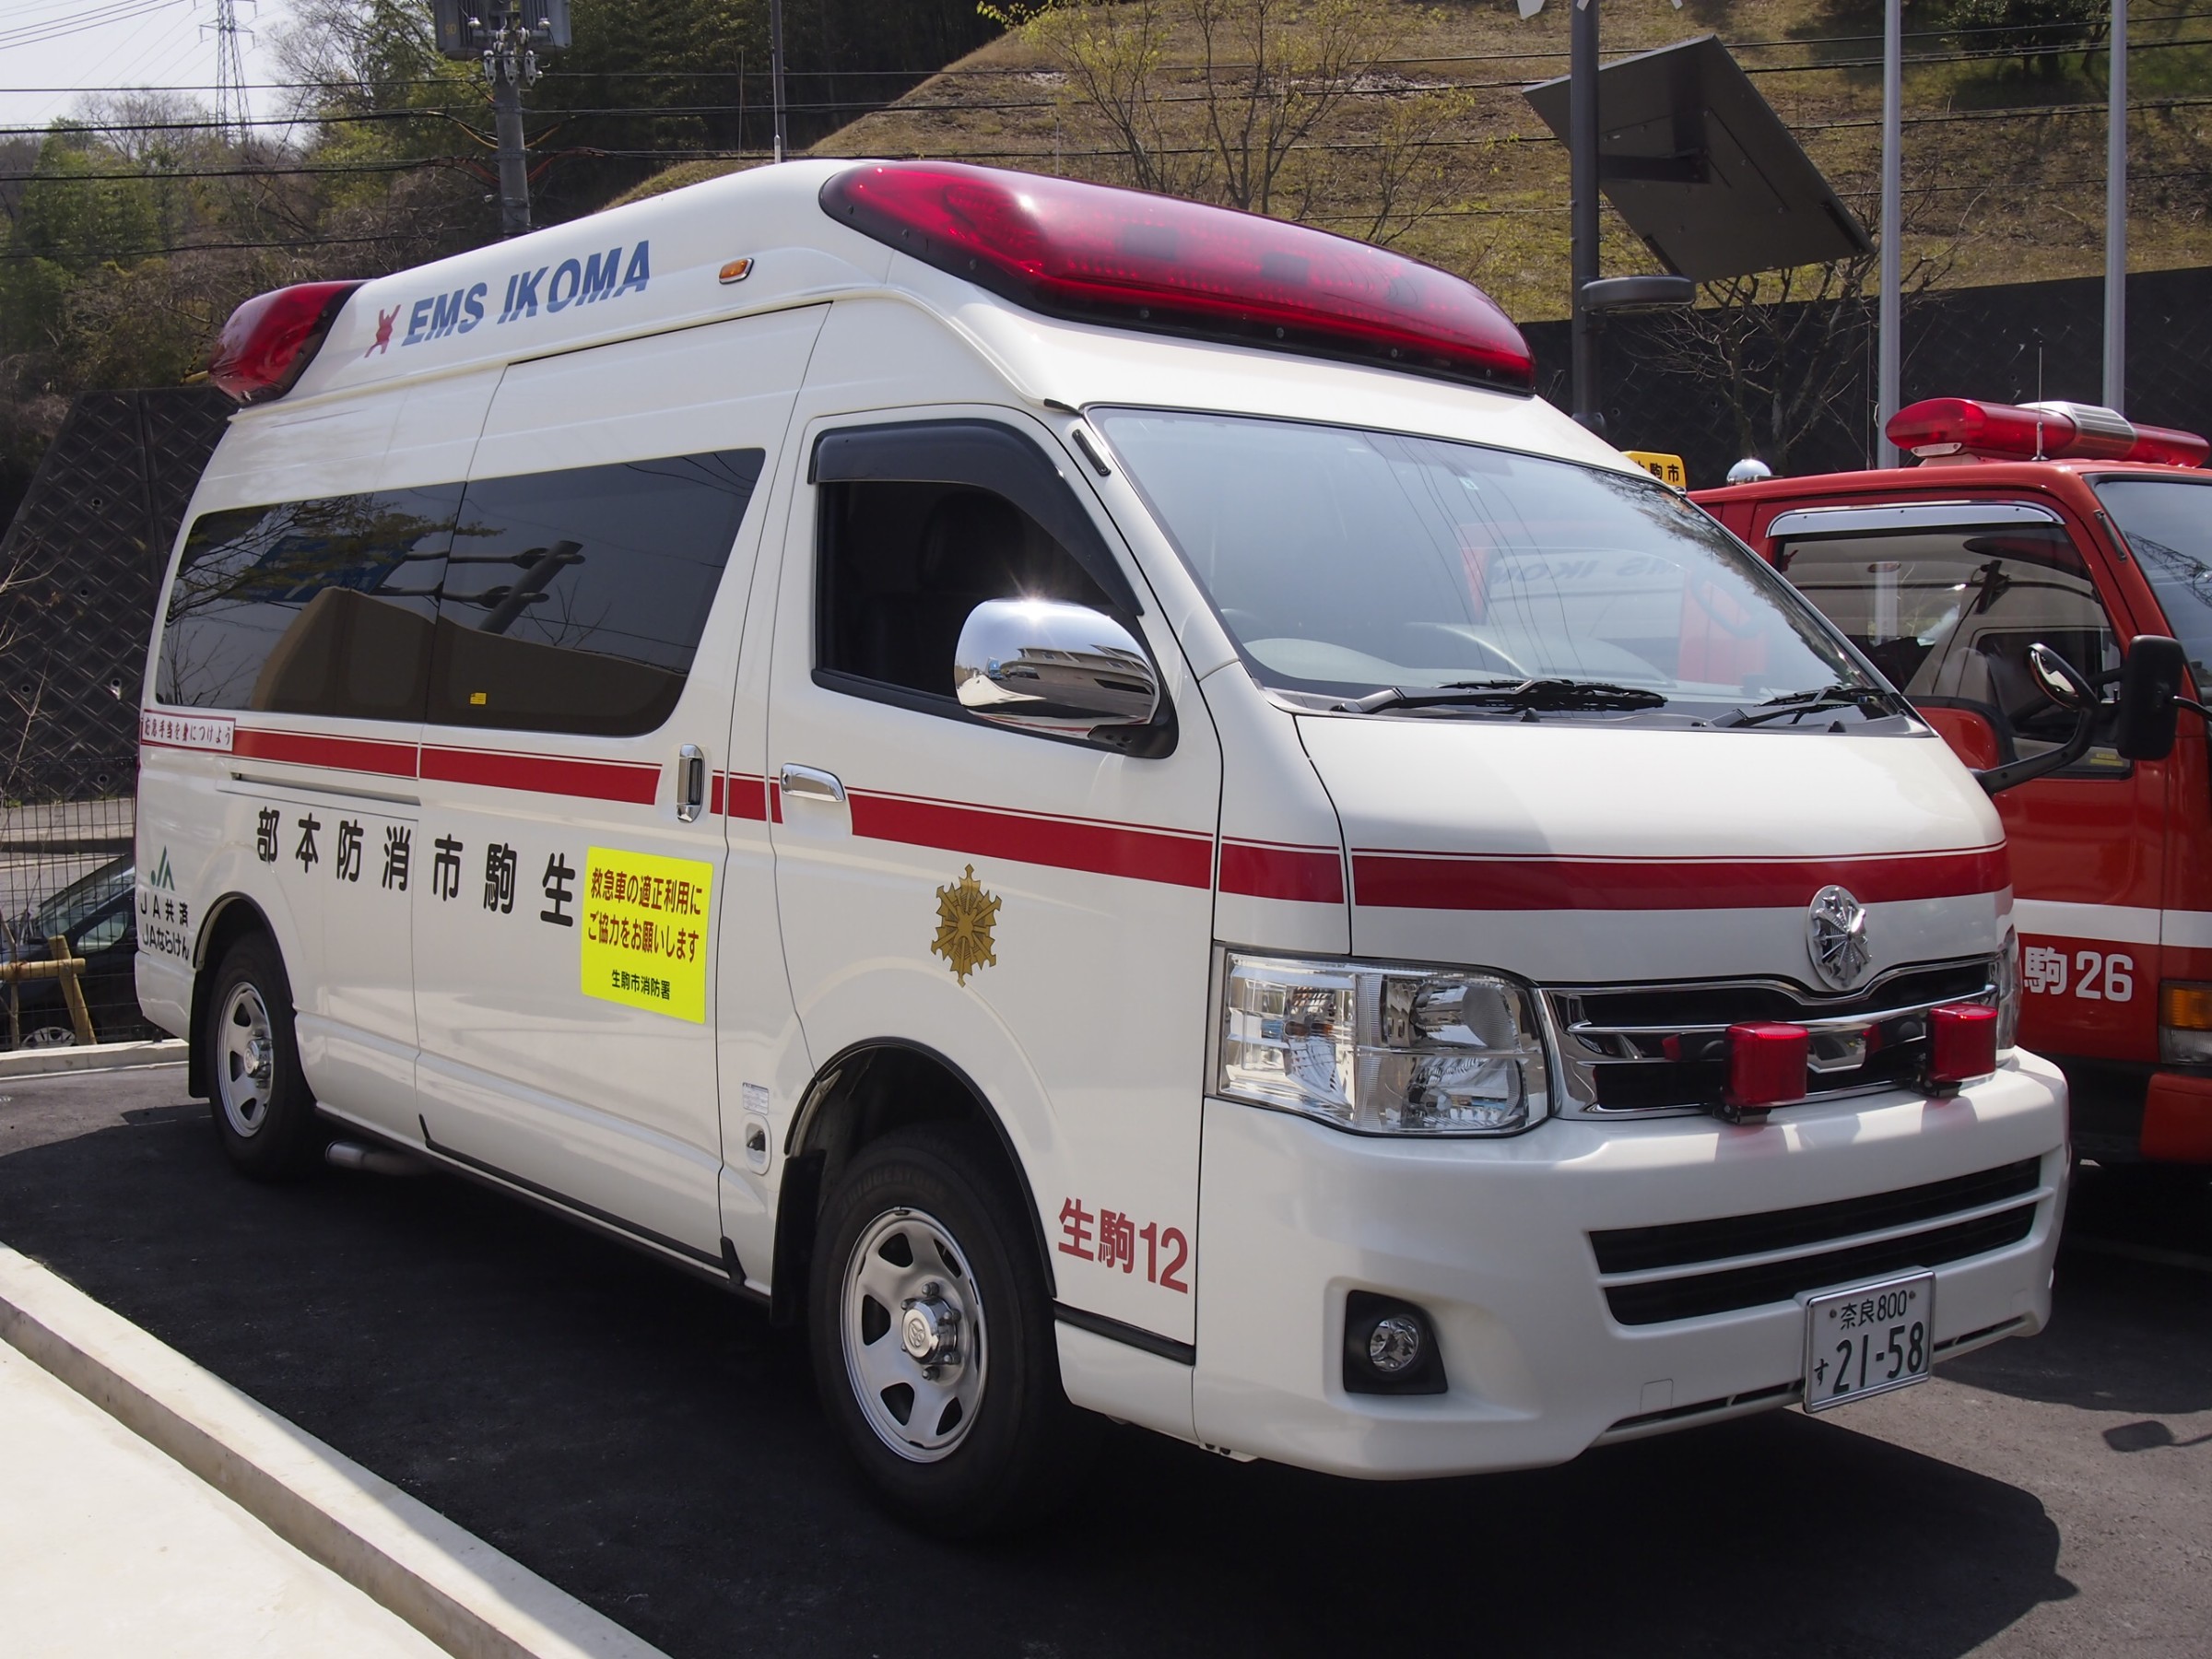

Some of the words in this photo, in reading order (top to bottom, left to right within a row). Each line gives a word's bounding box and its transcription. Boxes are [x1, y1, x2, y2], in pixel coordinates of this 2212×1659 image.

[401, 282, 488, 347] EMS
[497, 240, 650, 324] IKOMA
[591, 867, 703, 915] 救急車の適正利用に
[143, 923, 189, 960] JAならけん
[588, 910, 700, 963] ご協力をお願いします
[612, 970, 671, 1001] 生駒市消防署
[1058, 1196, 1188, 1295] 生駒12
[1814, 1359, 1830, 1386] す
[1833, 1321, 1924, 1395] 21-58
